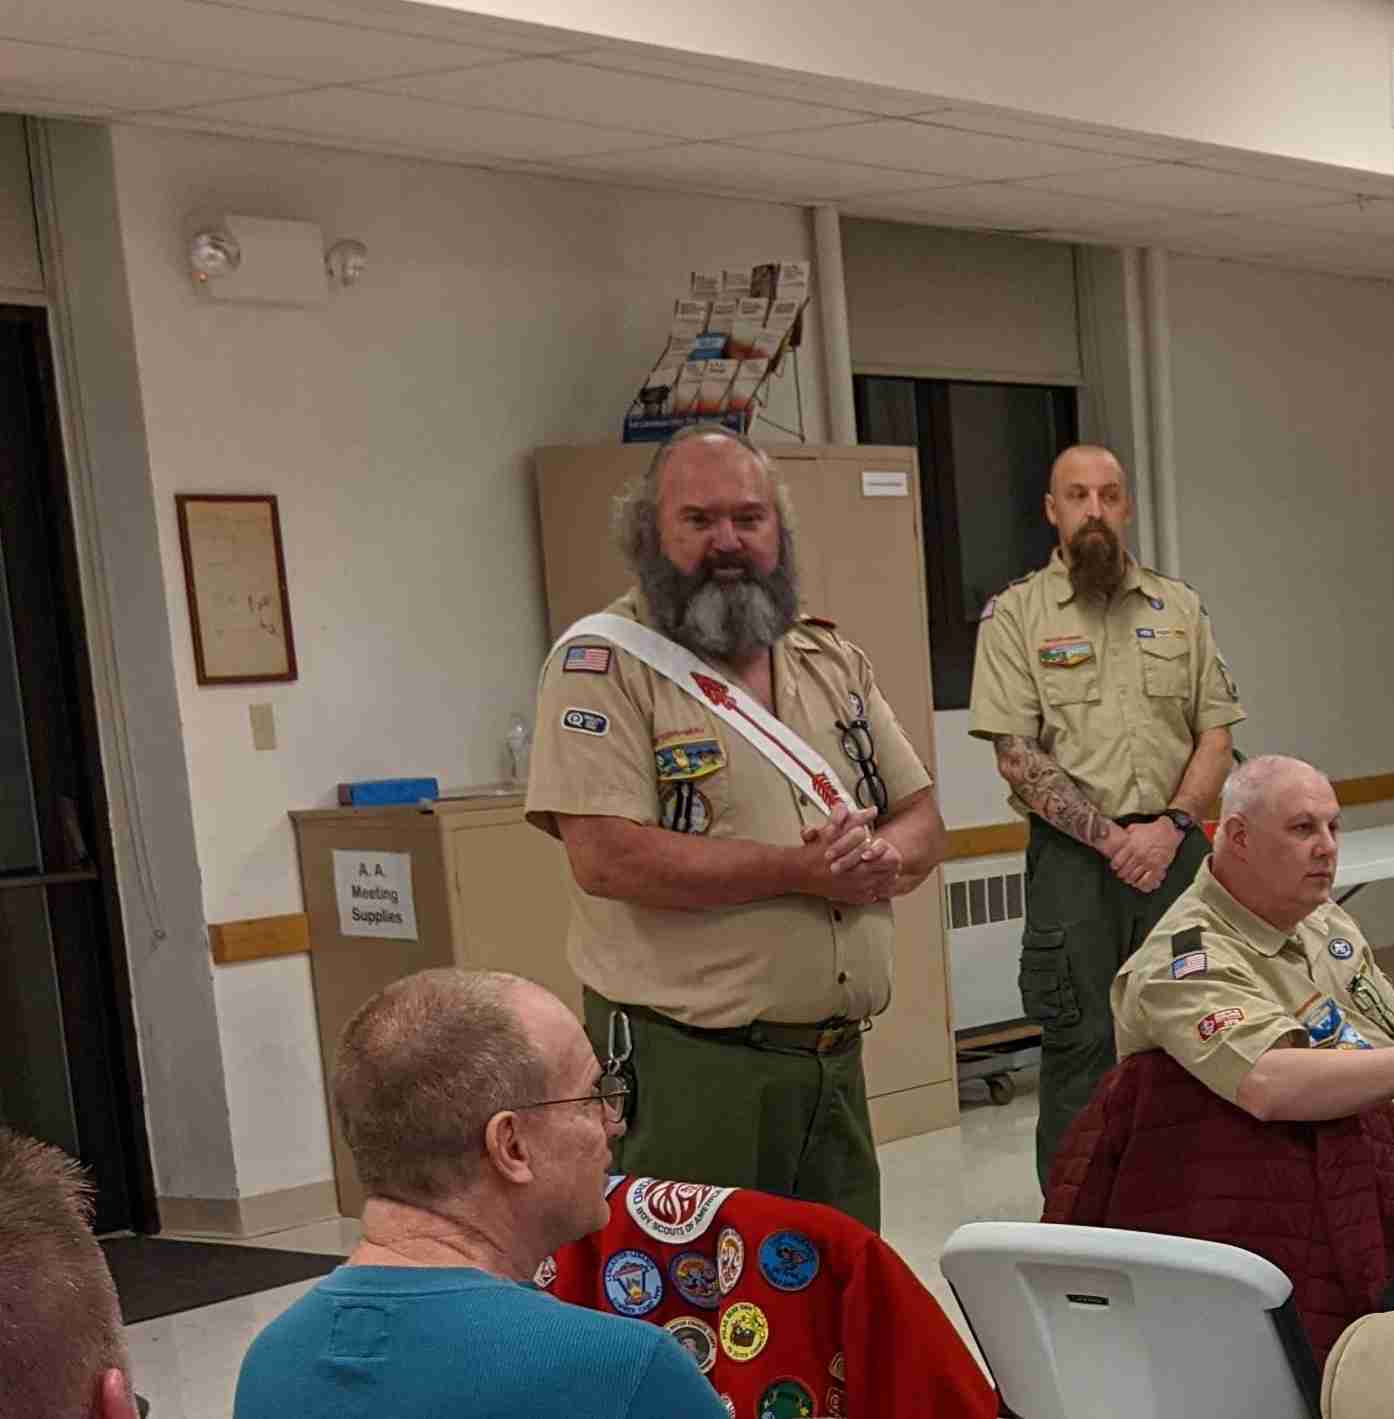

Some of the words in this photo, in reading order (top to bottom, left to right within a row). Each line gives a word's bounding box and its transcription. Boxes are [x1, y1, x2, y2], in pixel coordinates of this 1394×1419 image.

[351, 885, 399, 904] Meeting
[352, 907, 402, 925] Supplies
[636, 1207, 651, 1224] BOY
[652, 1221, 685, 1236] SCOUTS
[684, 1223, 694, 1233] OF
